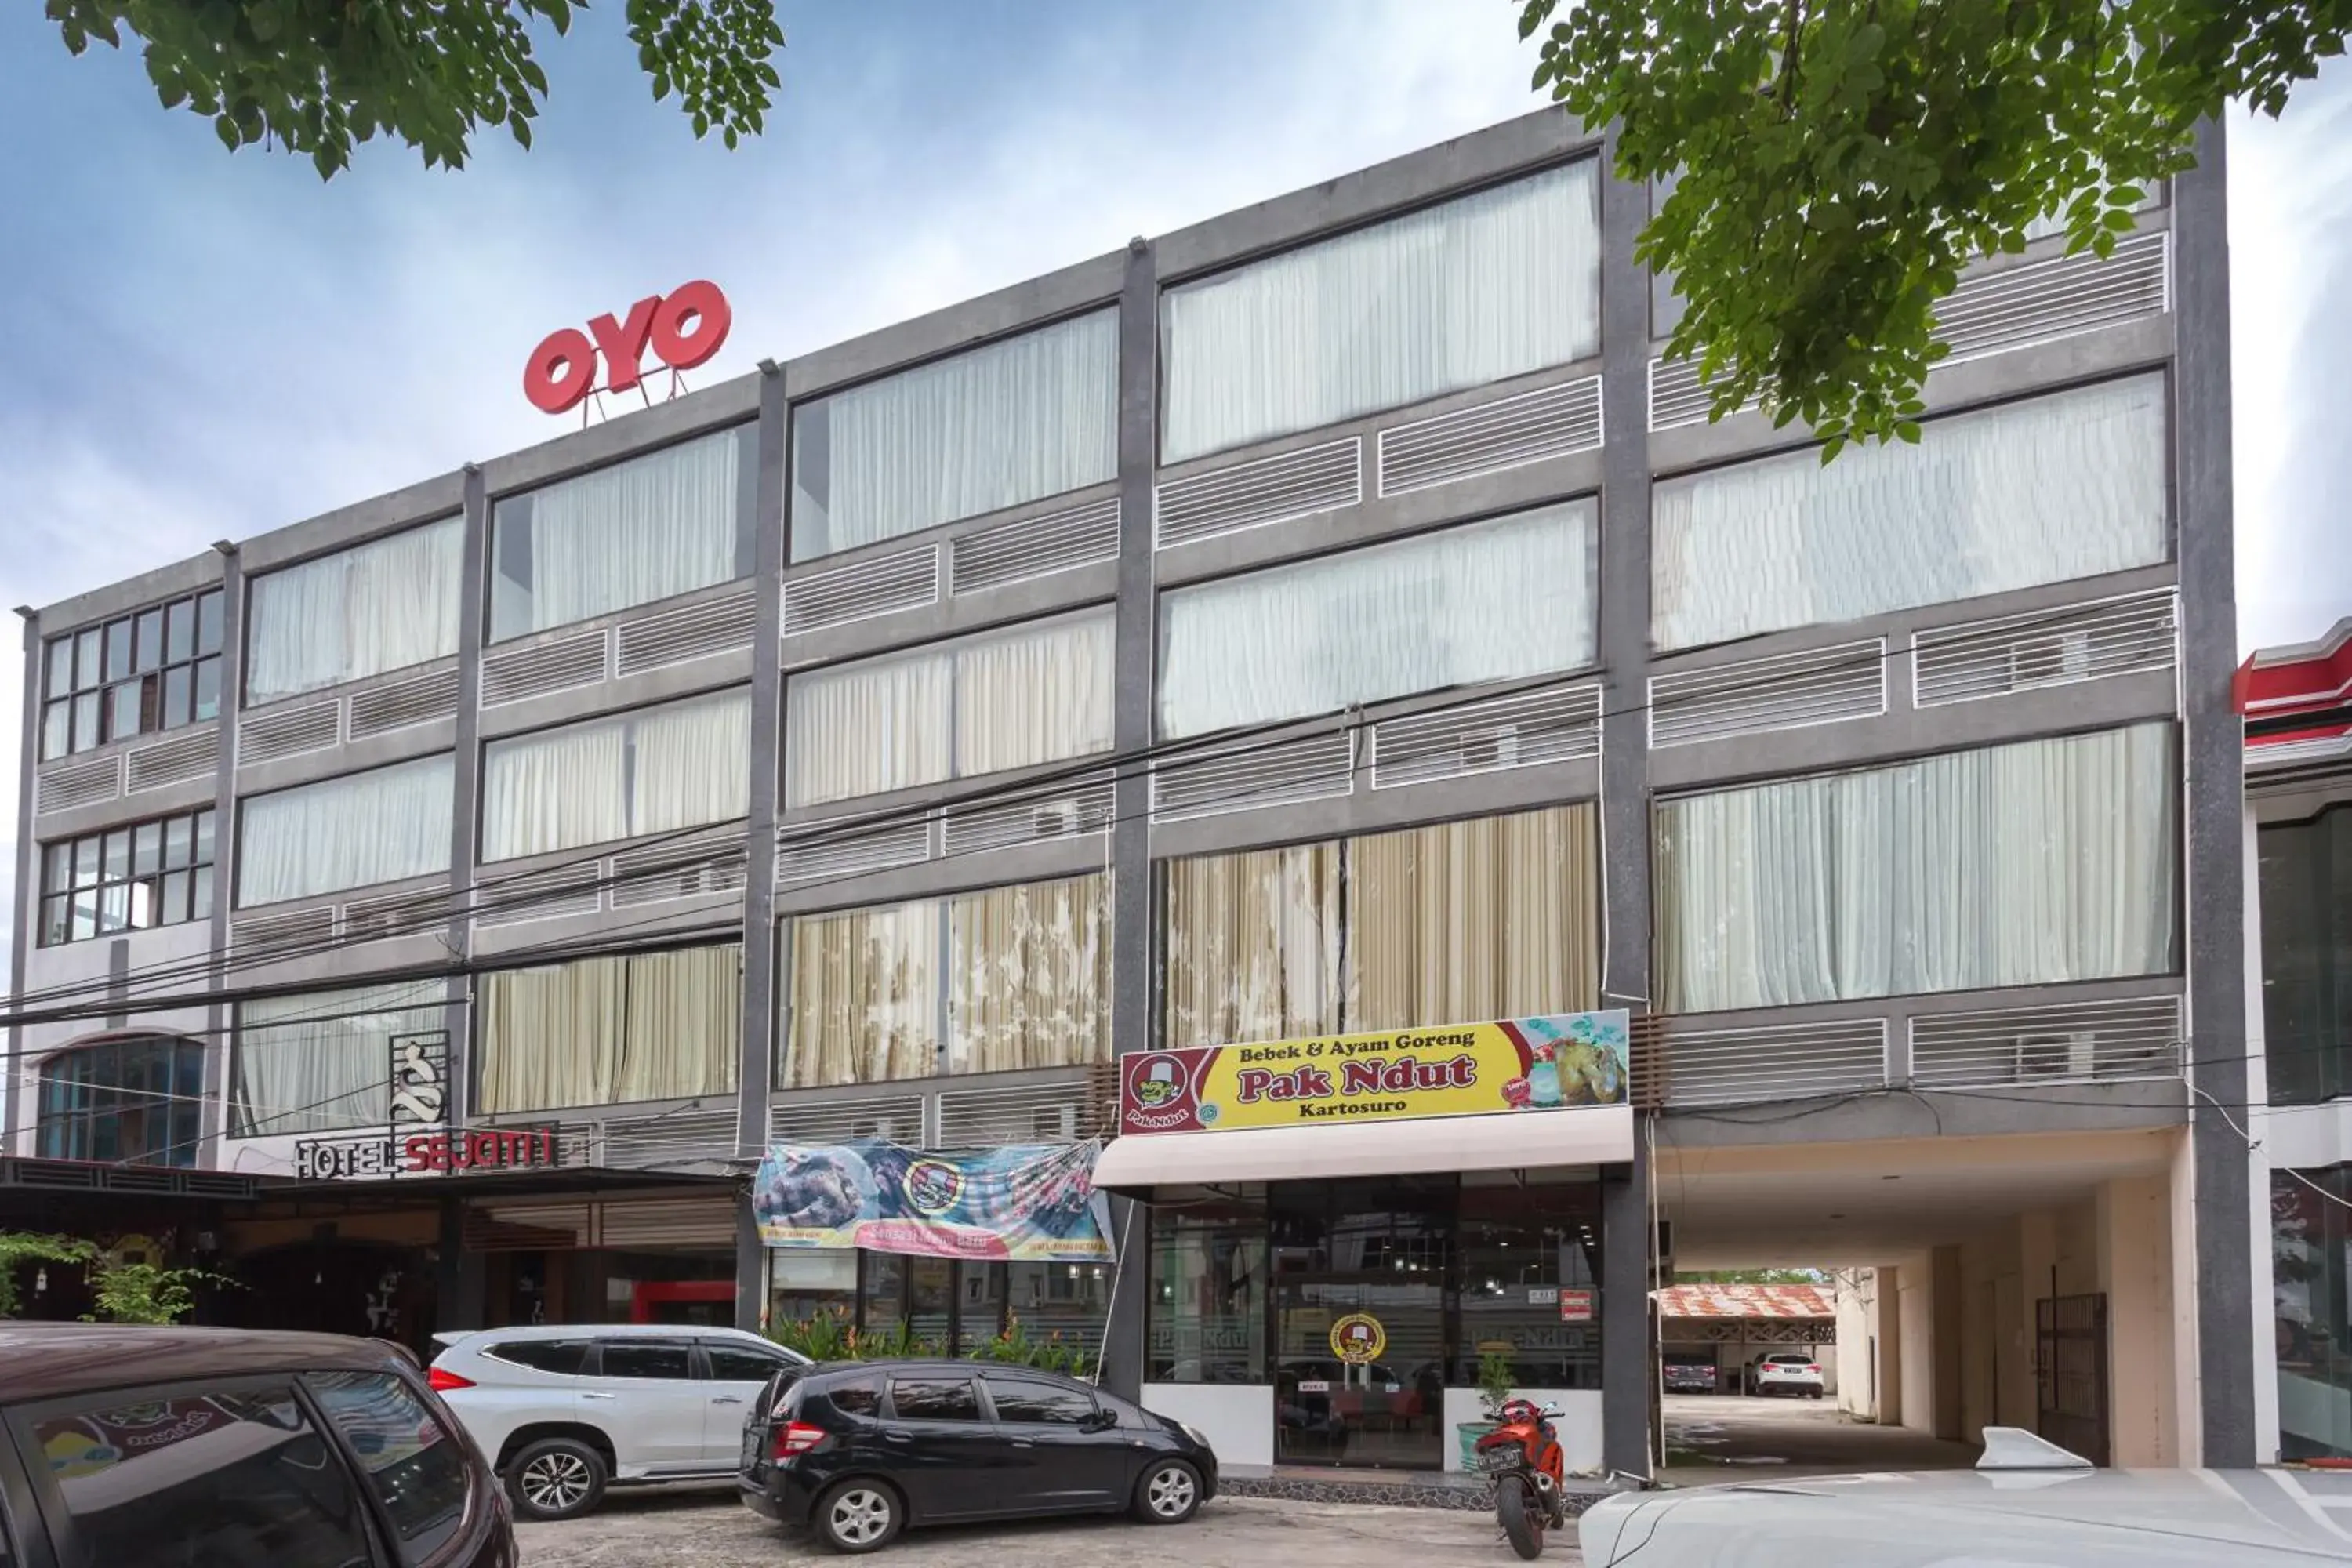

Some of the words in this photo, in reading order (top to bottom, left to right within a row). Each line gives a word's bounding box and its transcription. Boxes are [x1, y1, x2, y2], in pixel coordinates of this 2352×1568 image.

[524, 279, 731, 415] OYO
[1240, 1045, 1302, 1062] Bebek
[1306, 1042, 1324, 1057] &
[1330, 1038, 1390, 1057] Ayam
[1396, 1032, 1475, 1049] Goreng
[1237, 1064, 1334, 1103] Pak
[1340, 1053, 1478, 1094] Ndut
[1299, 1100, 1407, 1117] Kartosuro
[294, 1140, 401, 1179] HOTEL
